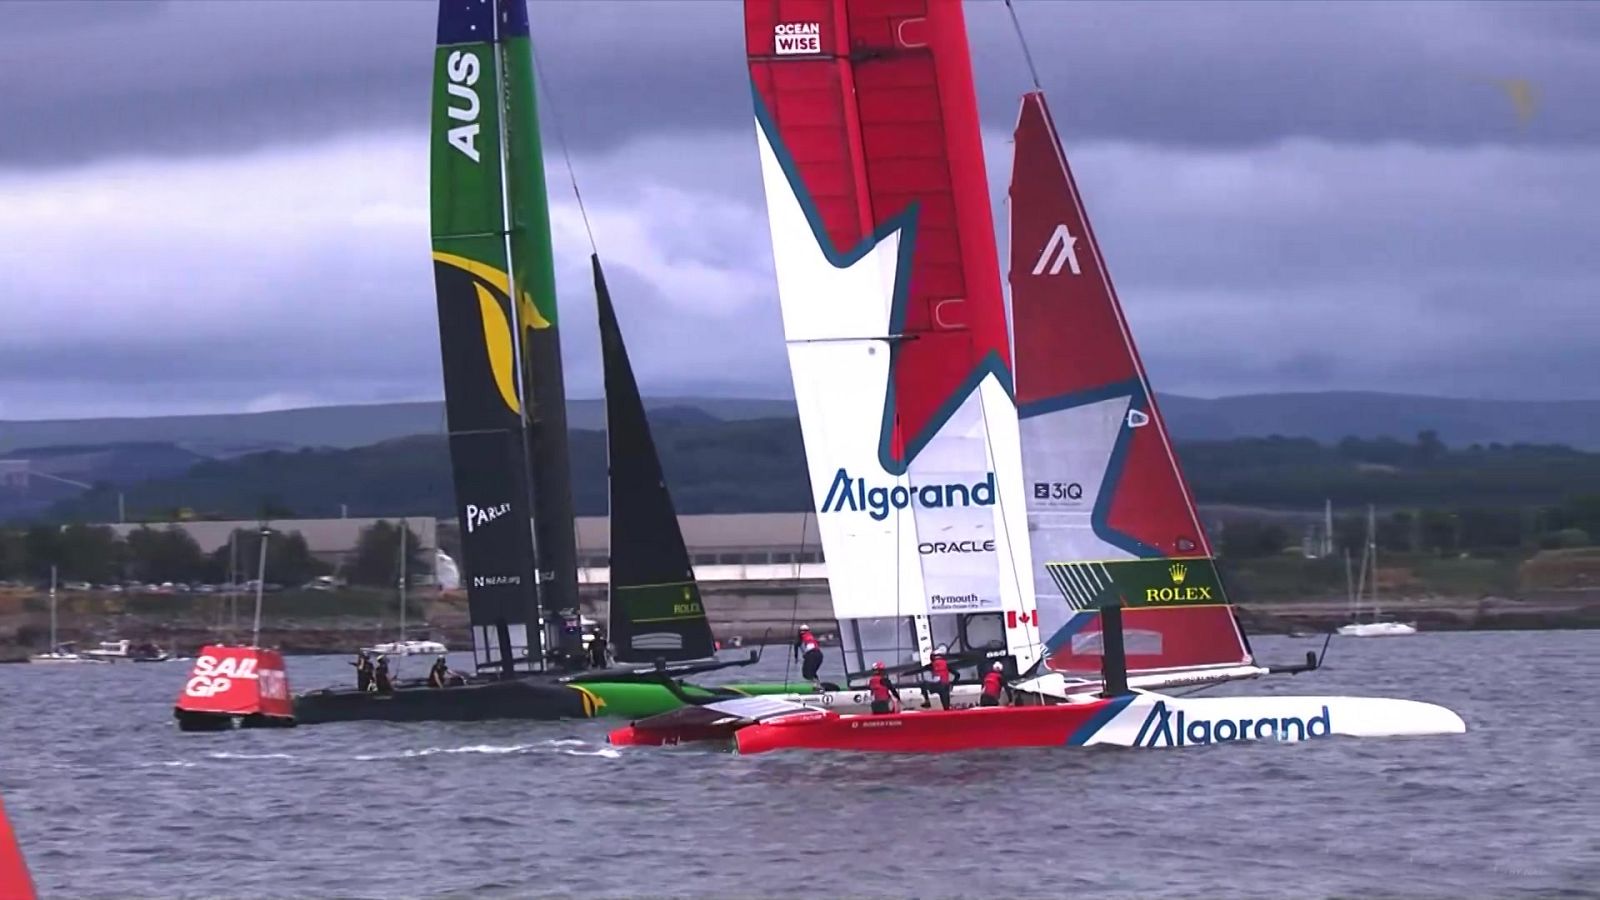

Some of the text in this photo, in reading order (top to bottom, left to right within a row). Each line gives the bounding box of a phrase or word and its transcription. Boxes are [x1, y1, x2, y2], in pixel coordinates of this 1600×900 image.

[775, 23, 820, 35] OCEAN
[778, 37, 818, 51] WISE
[447, 50, 481, 163] AUS
[821, 468, 996, 521] Algorand
[1052, 483, 1083, 500] 3iQ
[466, 502, 512, 533] PARLEY
[918, 540, 996, 555] ORACLE
[931, 593, 979, 606] Plymouth
[1146, 587, 1212, 602] ROLEX
[193, 655, 259, 679] SAIL
[185, 676, 232, 697] GP
